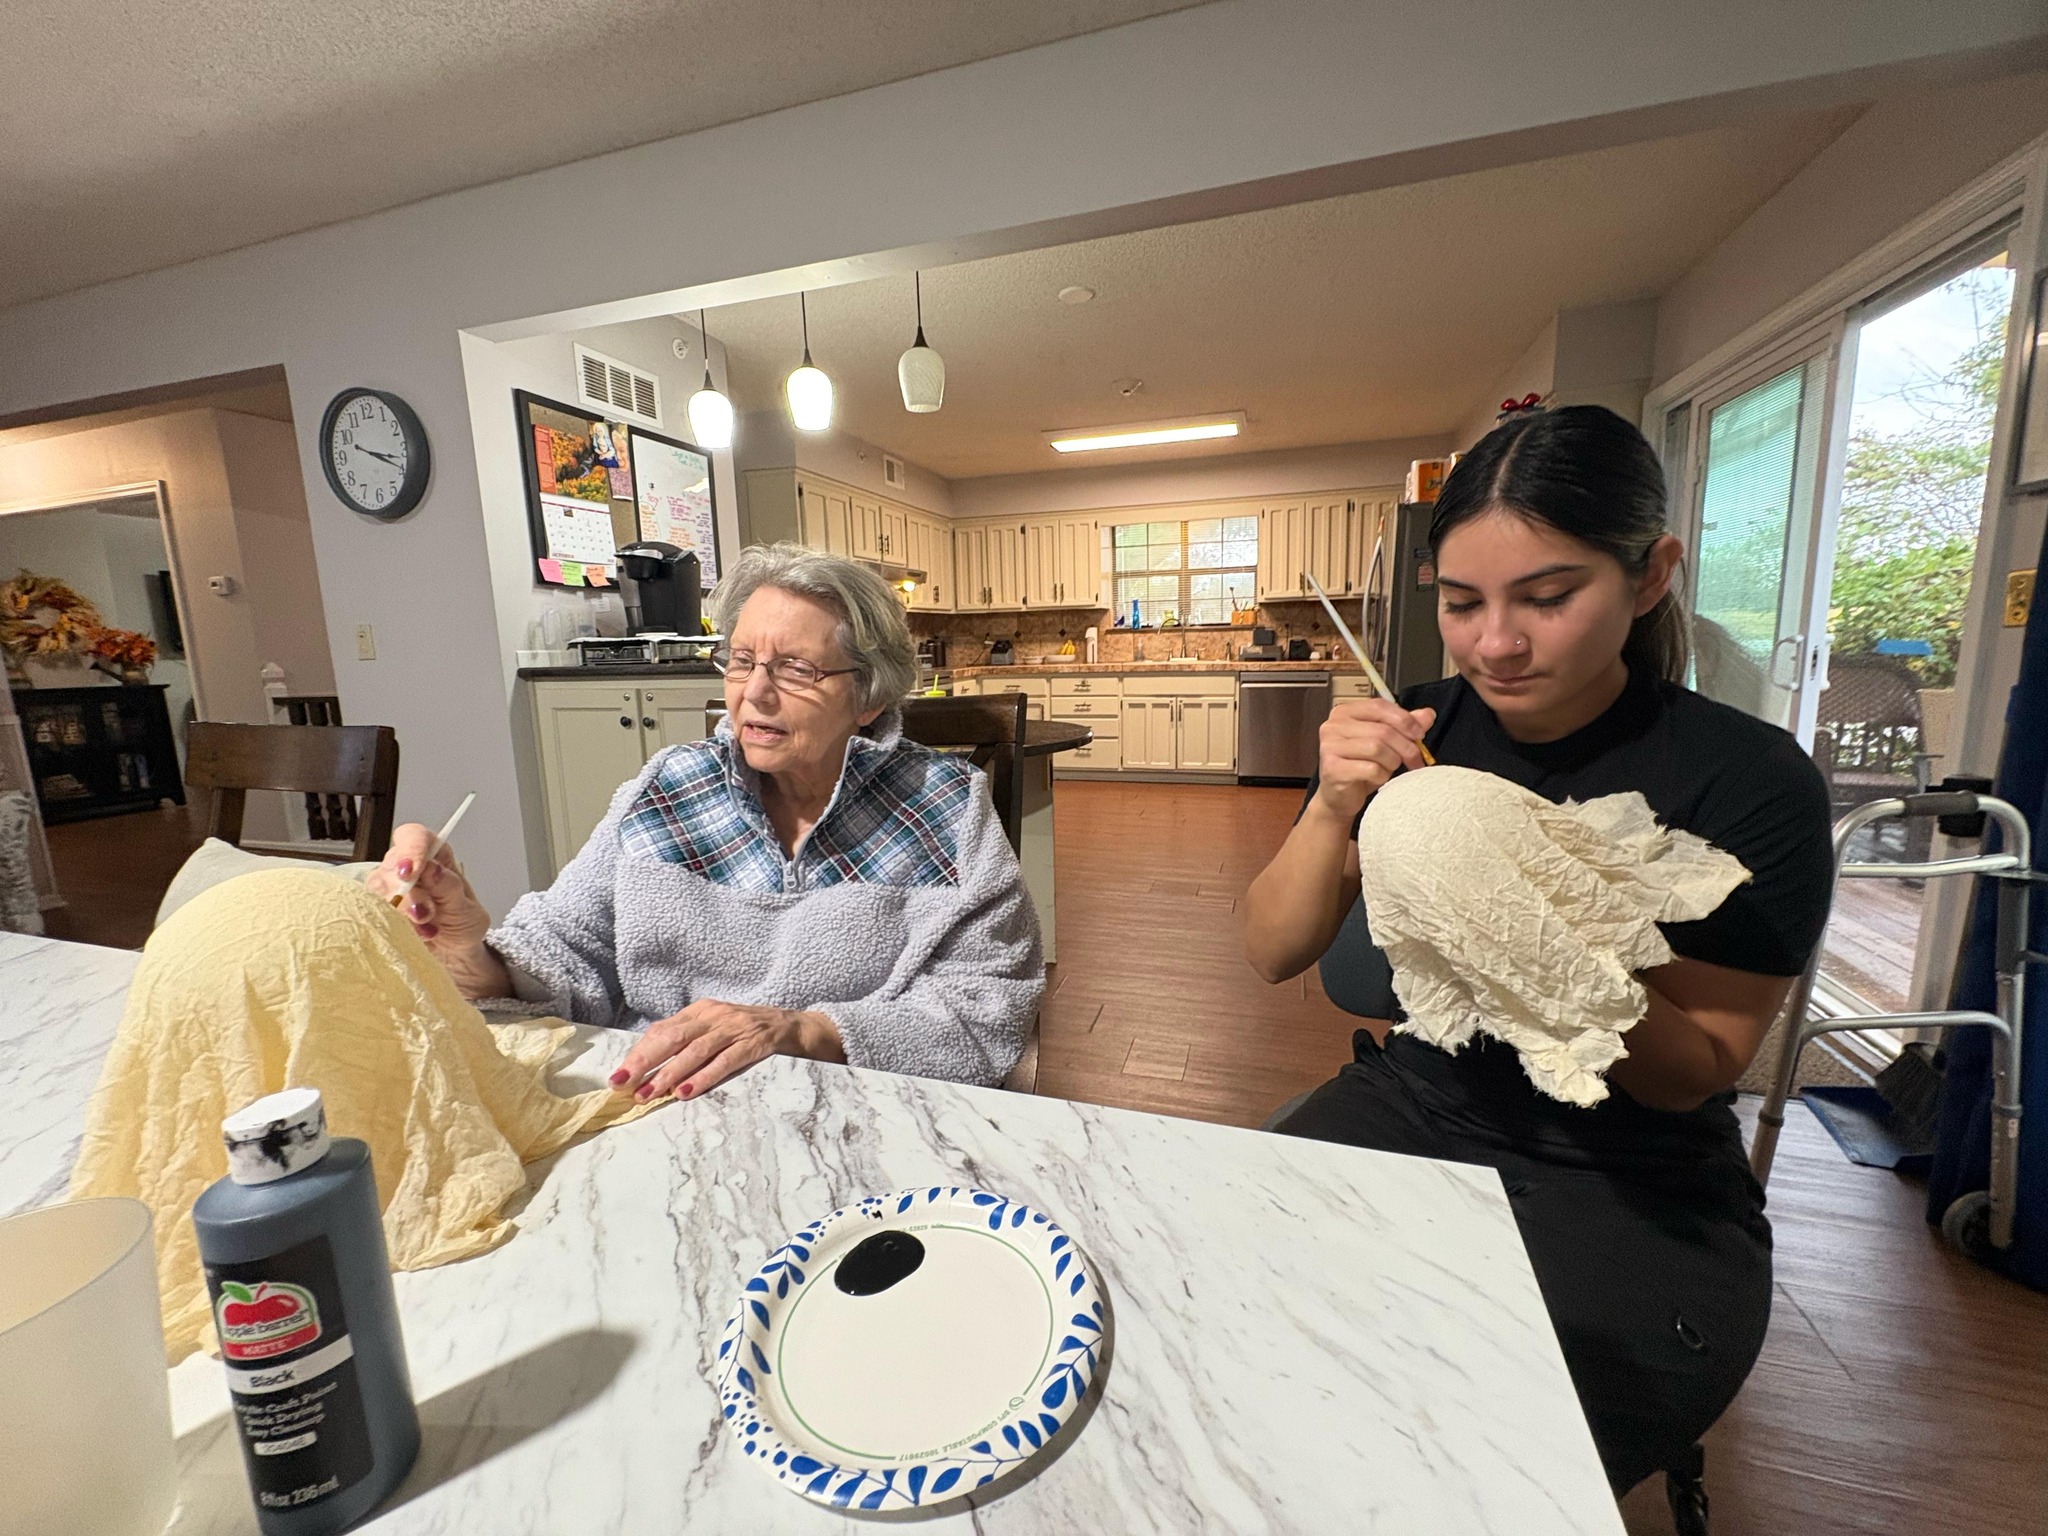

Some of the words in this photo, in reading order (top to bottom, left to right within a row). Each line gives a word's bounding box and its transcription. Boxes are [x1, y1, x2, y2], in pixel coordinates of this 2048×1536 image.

[360, 402, 374, 420] 12
[379, 406, 387, 423] 1
[348, 412, 360, 429] 11
[391, 420, 400, 437] 2
[340, 428, 353, 446] 10
[400, 441, 408, 458] 3
[339, 450, 348, 467] 9
[347, 470, 356, 487] 8
[360, 483, 369, 500] 7
[375, 488, 384, 504] 6
[390, 480, 398, 496] 5
[249, 1370, 294, 1388] Black
